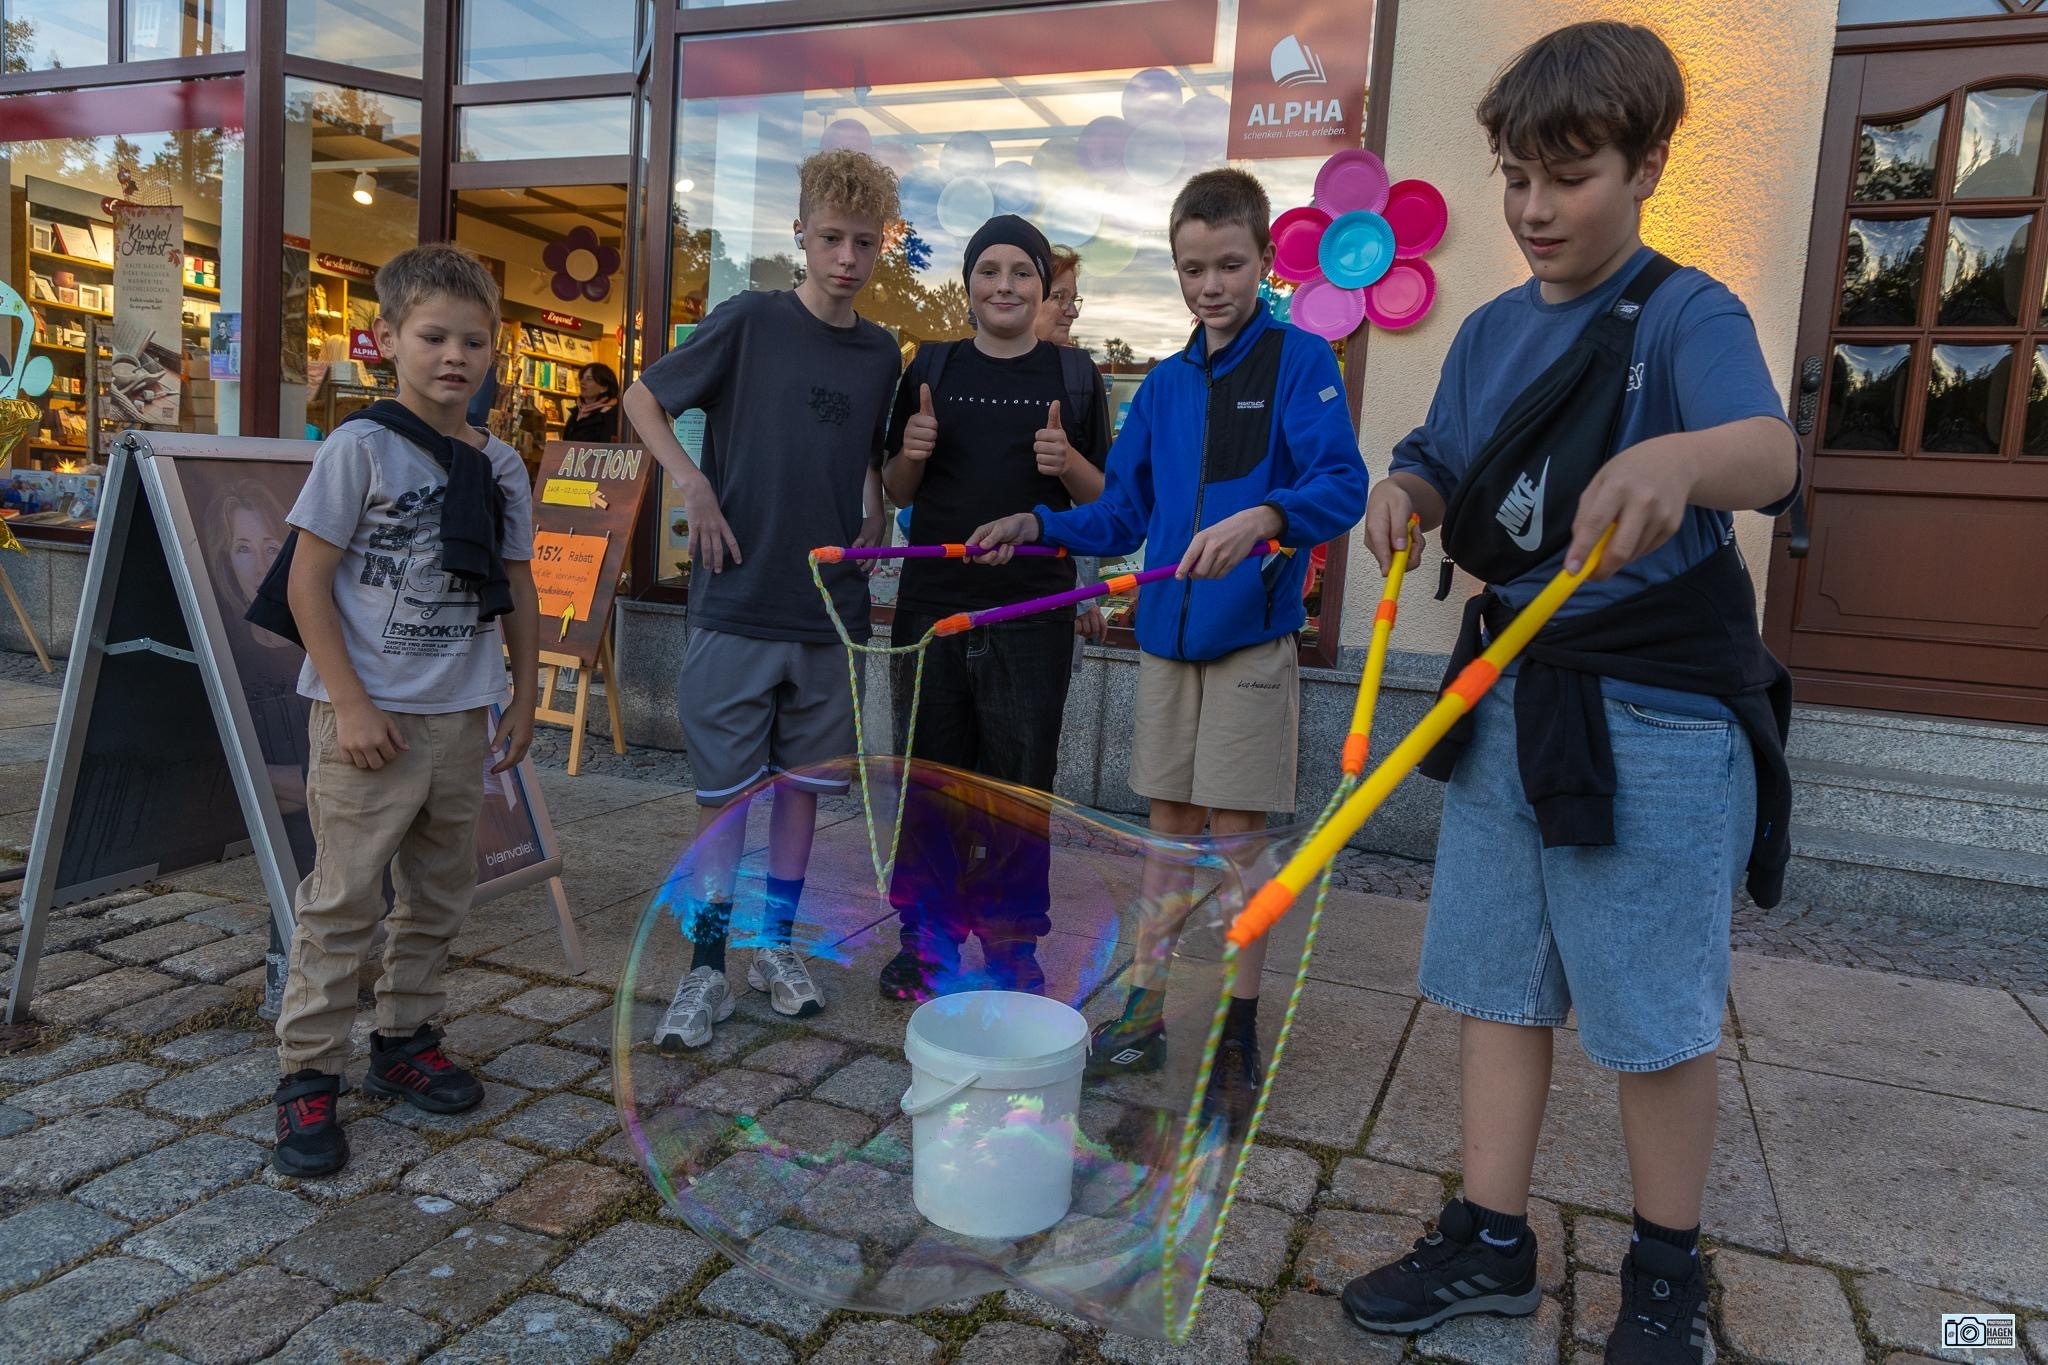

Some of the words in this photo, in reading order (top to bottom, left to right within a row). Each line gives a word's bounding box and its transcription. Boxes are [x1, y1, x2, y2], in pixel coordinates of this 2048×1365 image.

[1247, 99, 1343, 126] ALPHA
[1244, 130, 1284, 140] schenken.
[1286, 128, 1310, 138] lesen.
[1312, 127, 1346, 136] erleben.
[128, 223, 172, 242] Kuschel
[122, 240, 173, 256] Herbst
[352, 348, 378, 356] ALPHA
[558, 448, 642, 480] AKTION
[1496, 472, 1540, 535] NIKE
[537, 545, 562, 562] 15%
[568, 550, 594, 564] Rabatt
[485, 841, 534, 866] blanvalet
